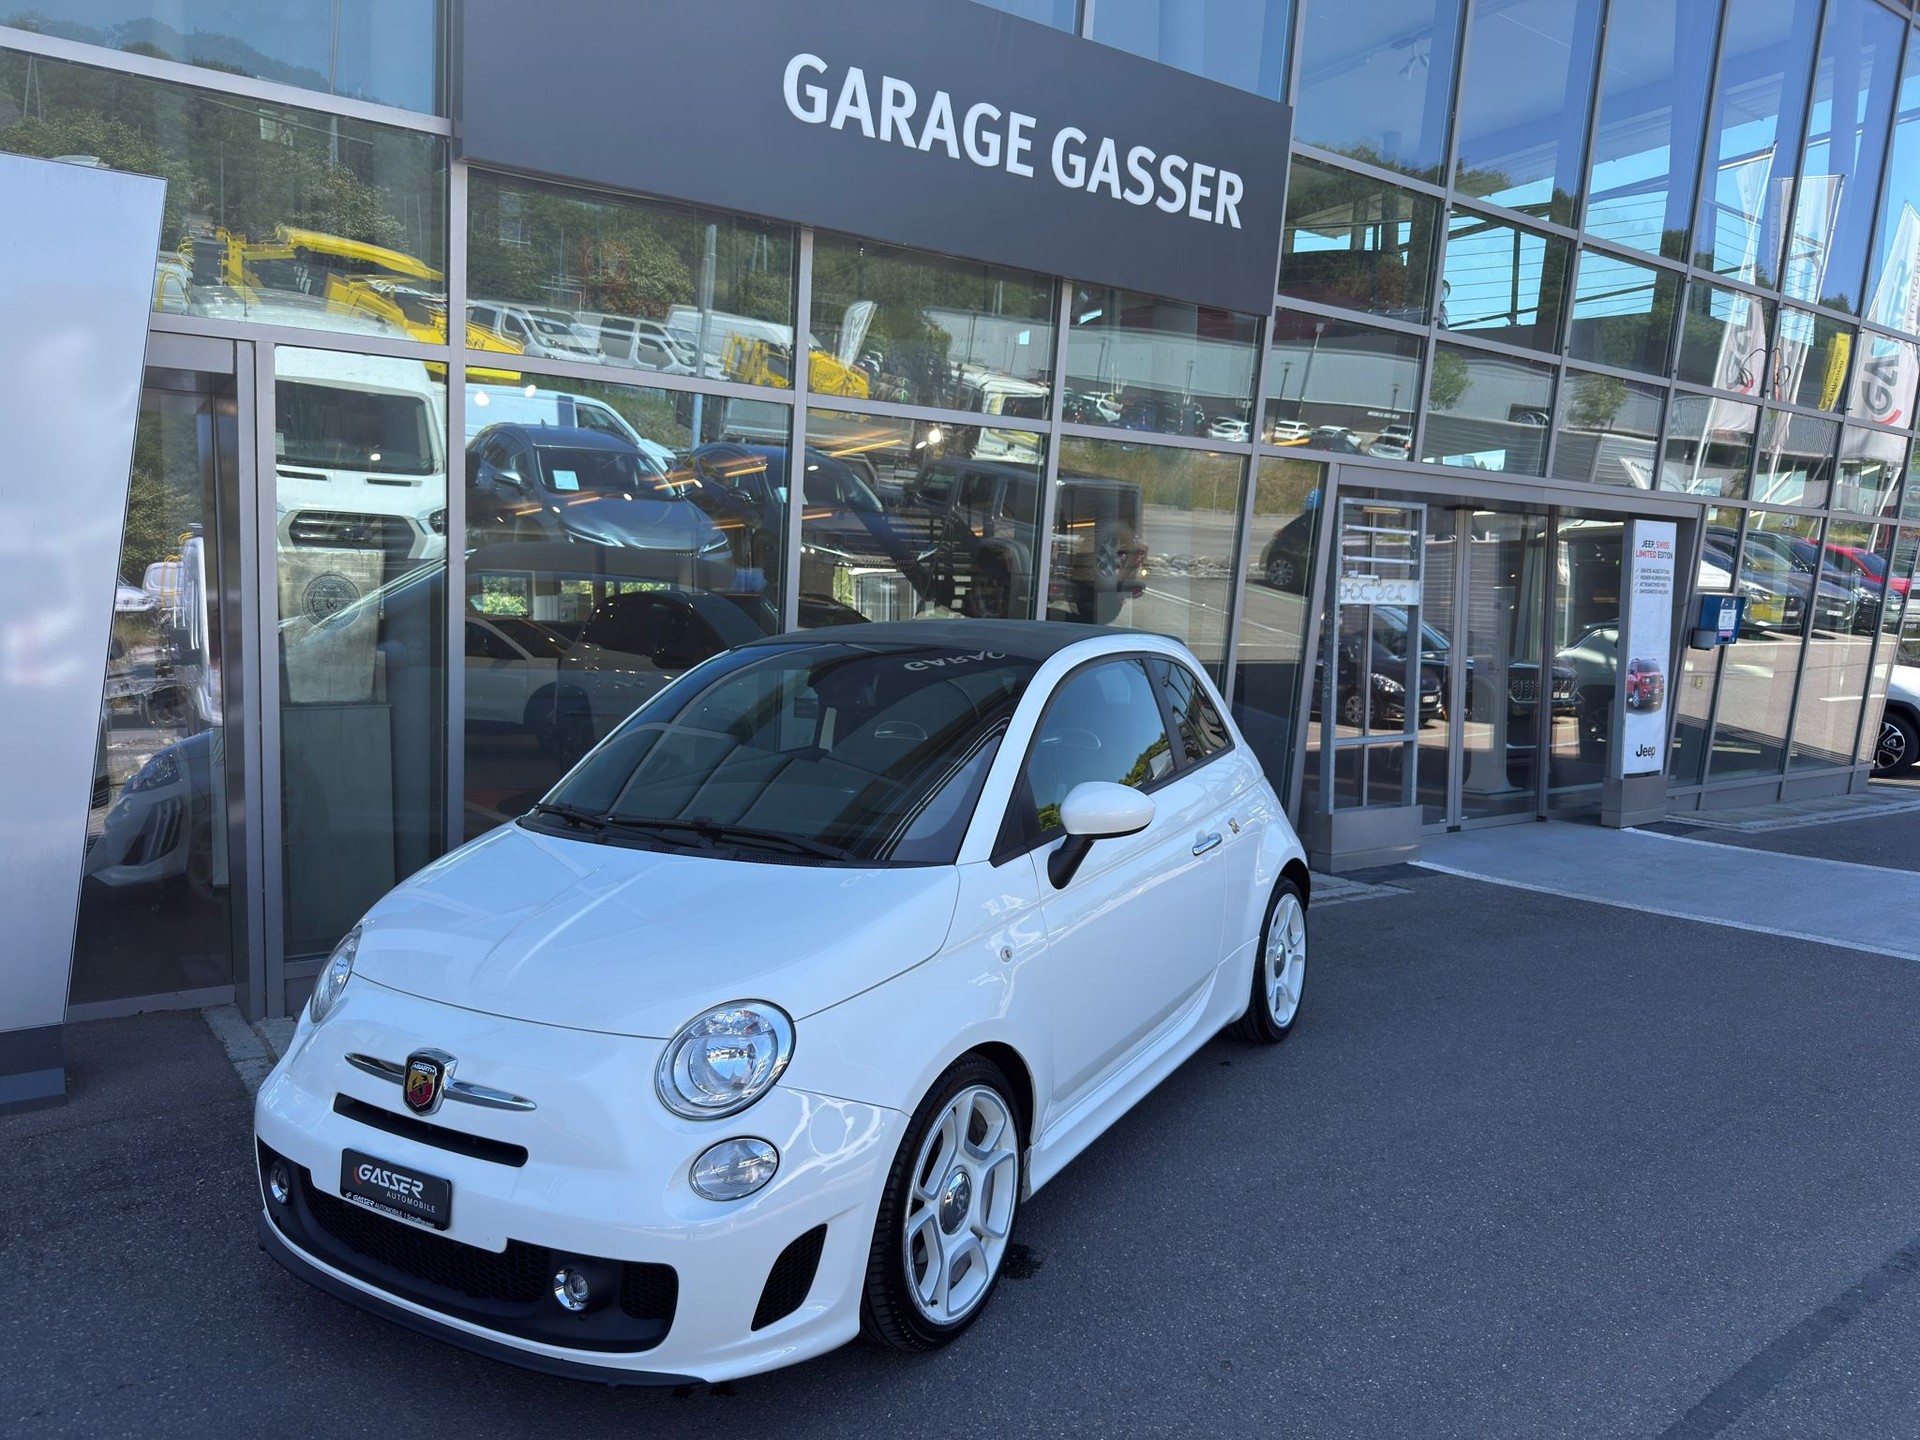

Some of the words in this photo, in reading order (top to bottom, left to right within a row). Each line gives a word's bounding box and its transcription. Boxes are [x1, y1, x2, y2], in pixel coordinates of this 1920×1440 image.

[783, 53, 1037, 178] GARAGE
[1051, 126, 1244, 229] GASSER
[1636, 550, 1657, 559] LIMITED
[1636, 744, 1656, 759] Jeep
[413, 1063, 436, 1074] ABARTH
[358, 1163, 425, 1200] GASSER
[352, 1194, 375, 1207] GASSER
[375, 1202, 403, 1217] AUTOMOBILE
[385, 1190, 436, 1214] AUTOMOBILE
